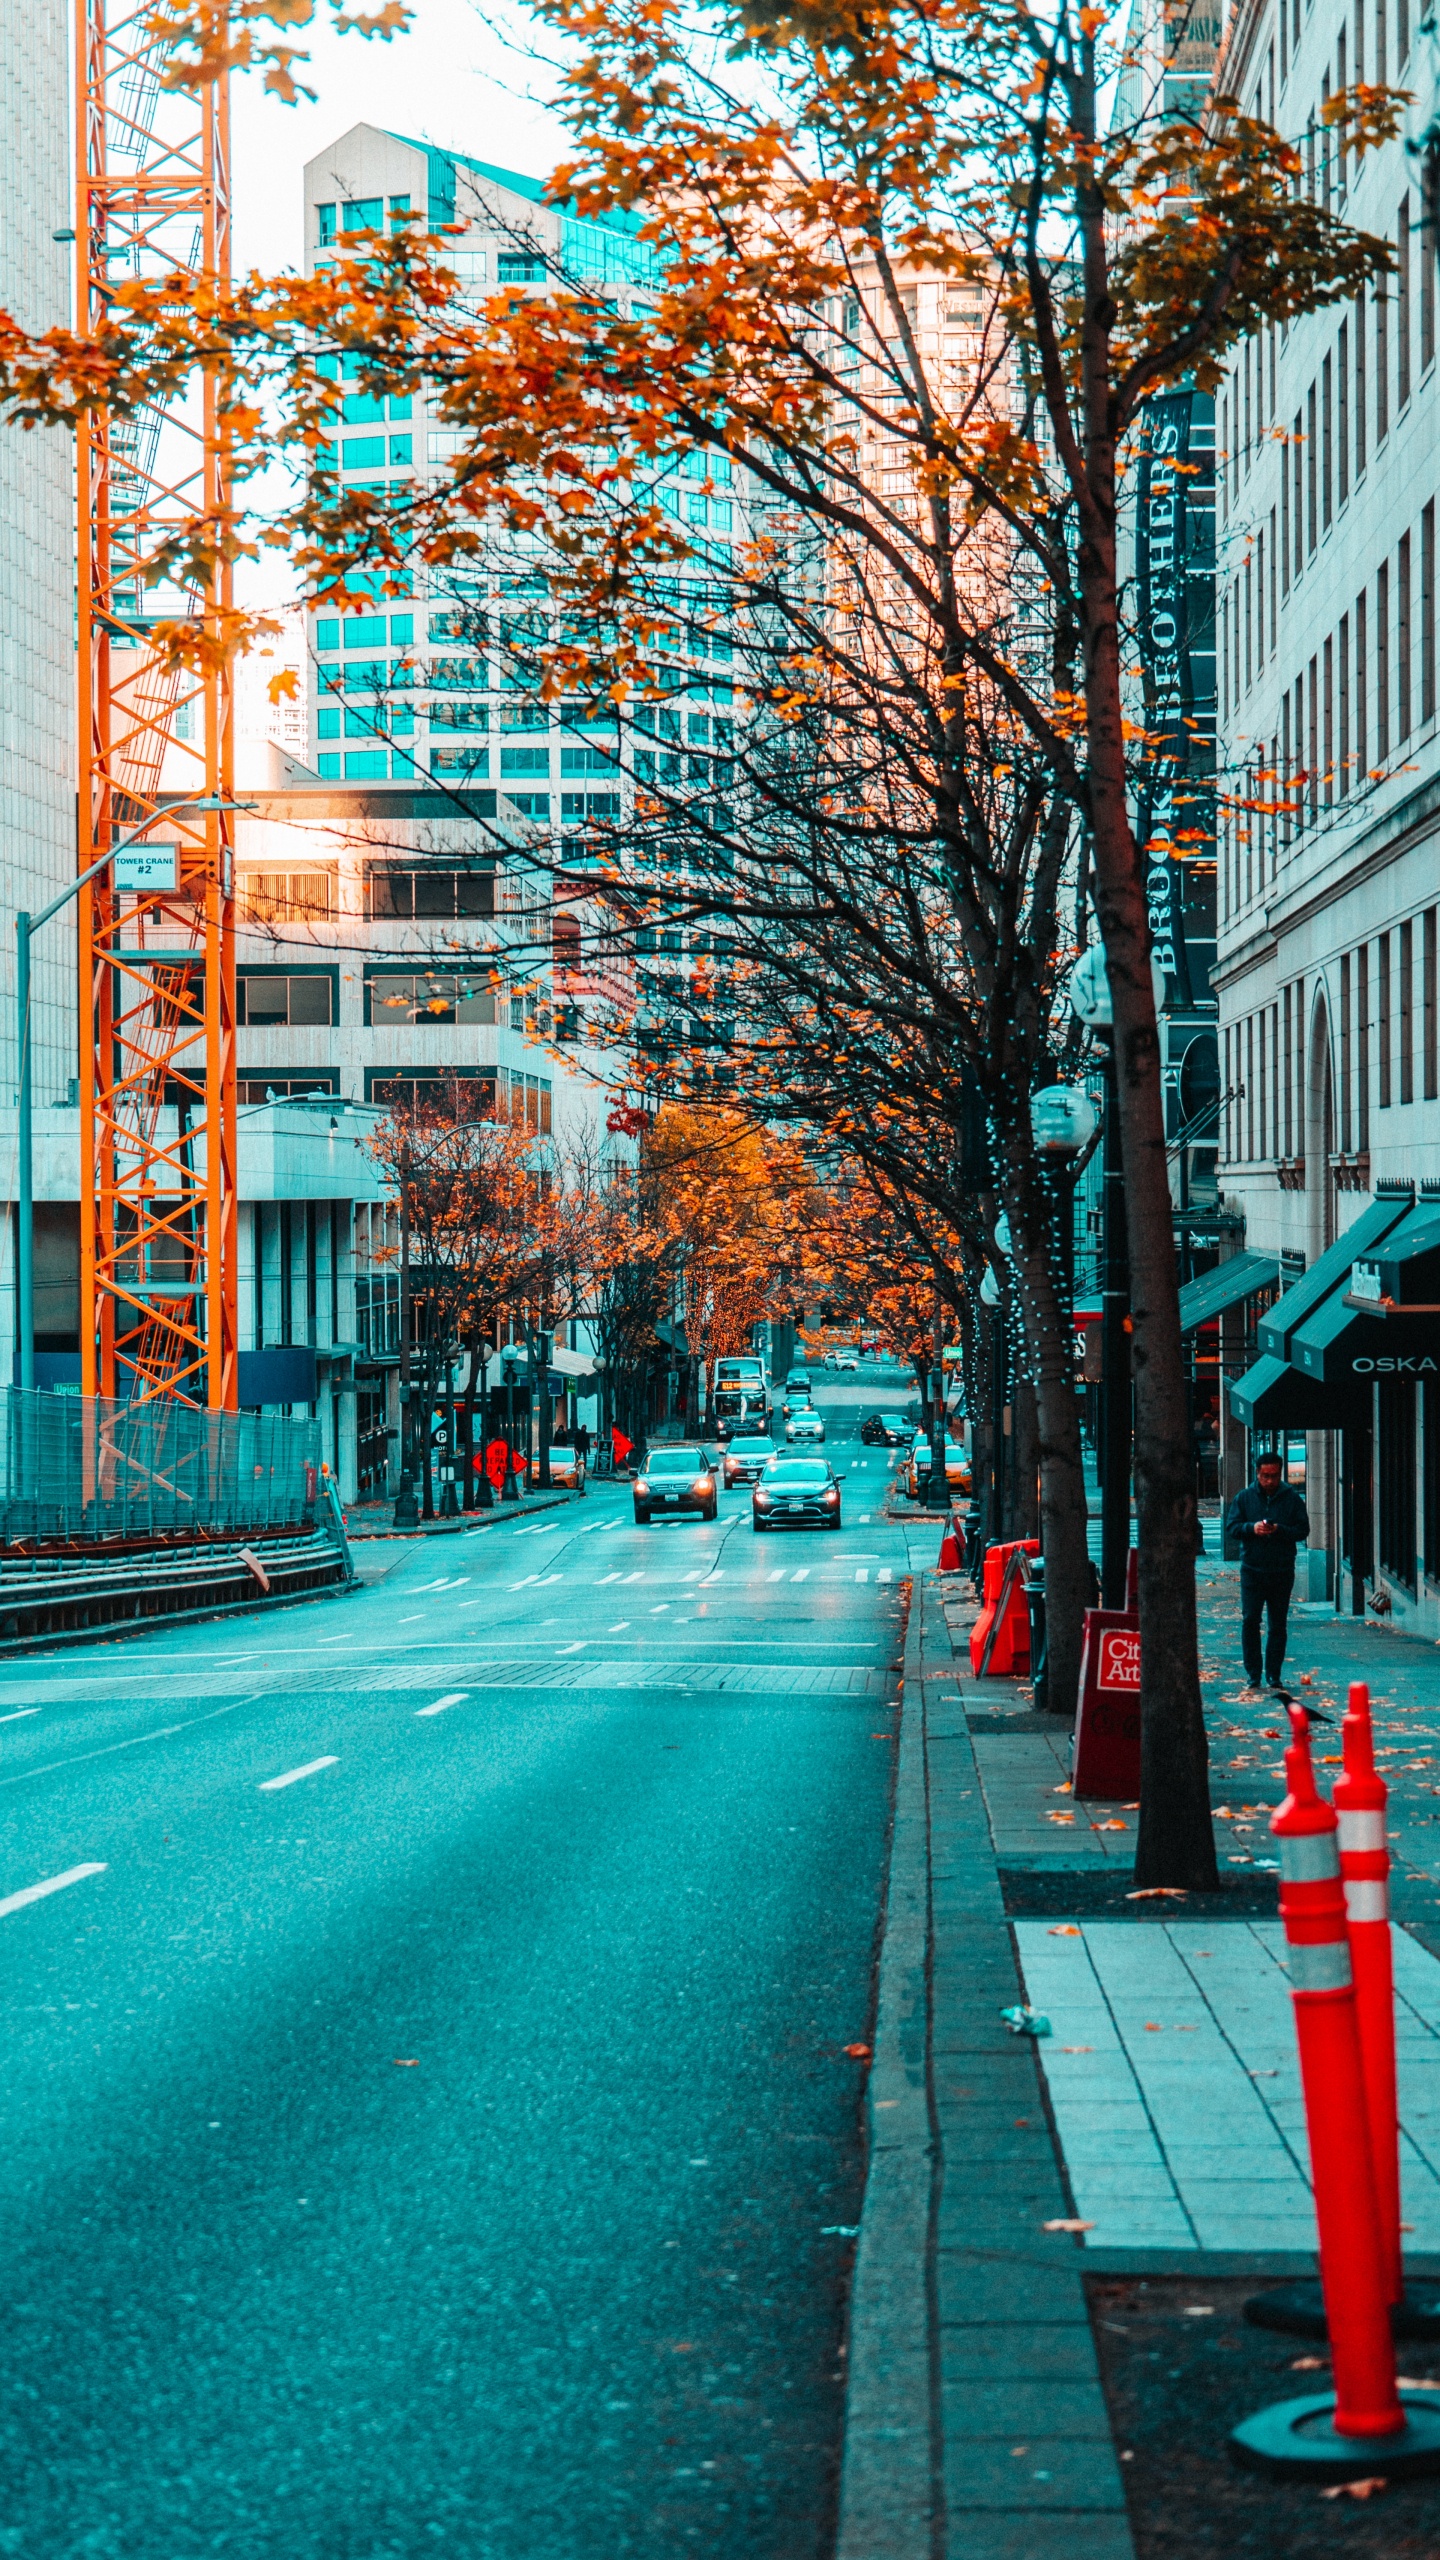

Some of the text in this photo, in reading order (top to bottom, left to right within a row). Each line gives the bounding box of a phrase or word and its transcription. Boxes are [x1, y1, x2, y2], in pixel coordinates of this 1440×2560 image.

[1149, 425, 1182, 722] BROTHERS
[138, 865, 152, 874] #2
[1352, 1356, 1438, 1373] OSKA
[56, 1384, 80, 1394] Union
[495, 1448, 505, 1457] BE
[1108, 1639, 1140, 1660] Cit
[1106, 1660, 1141, 1682] Art
